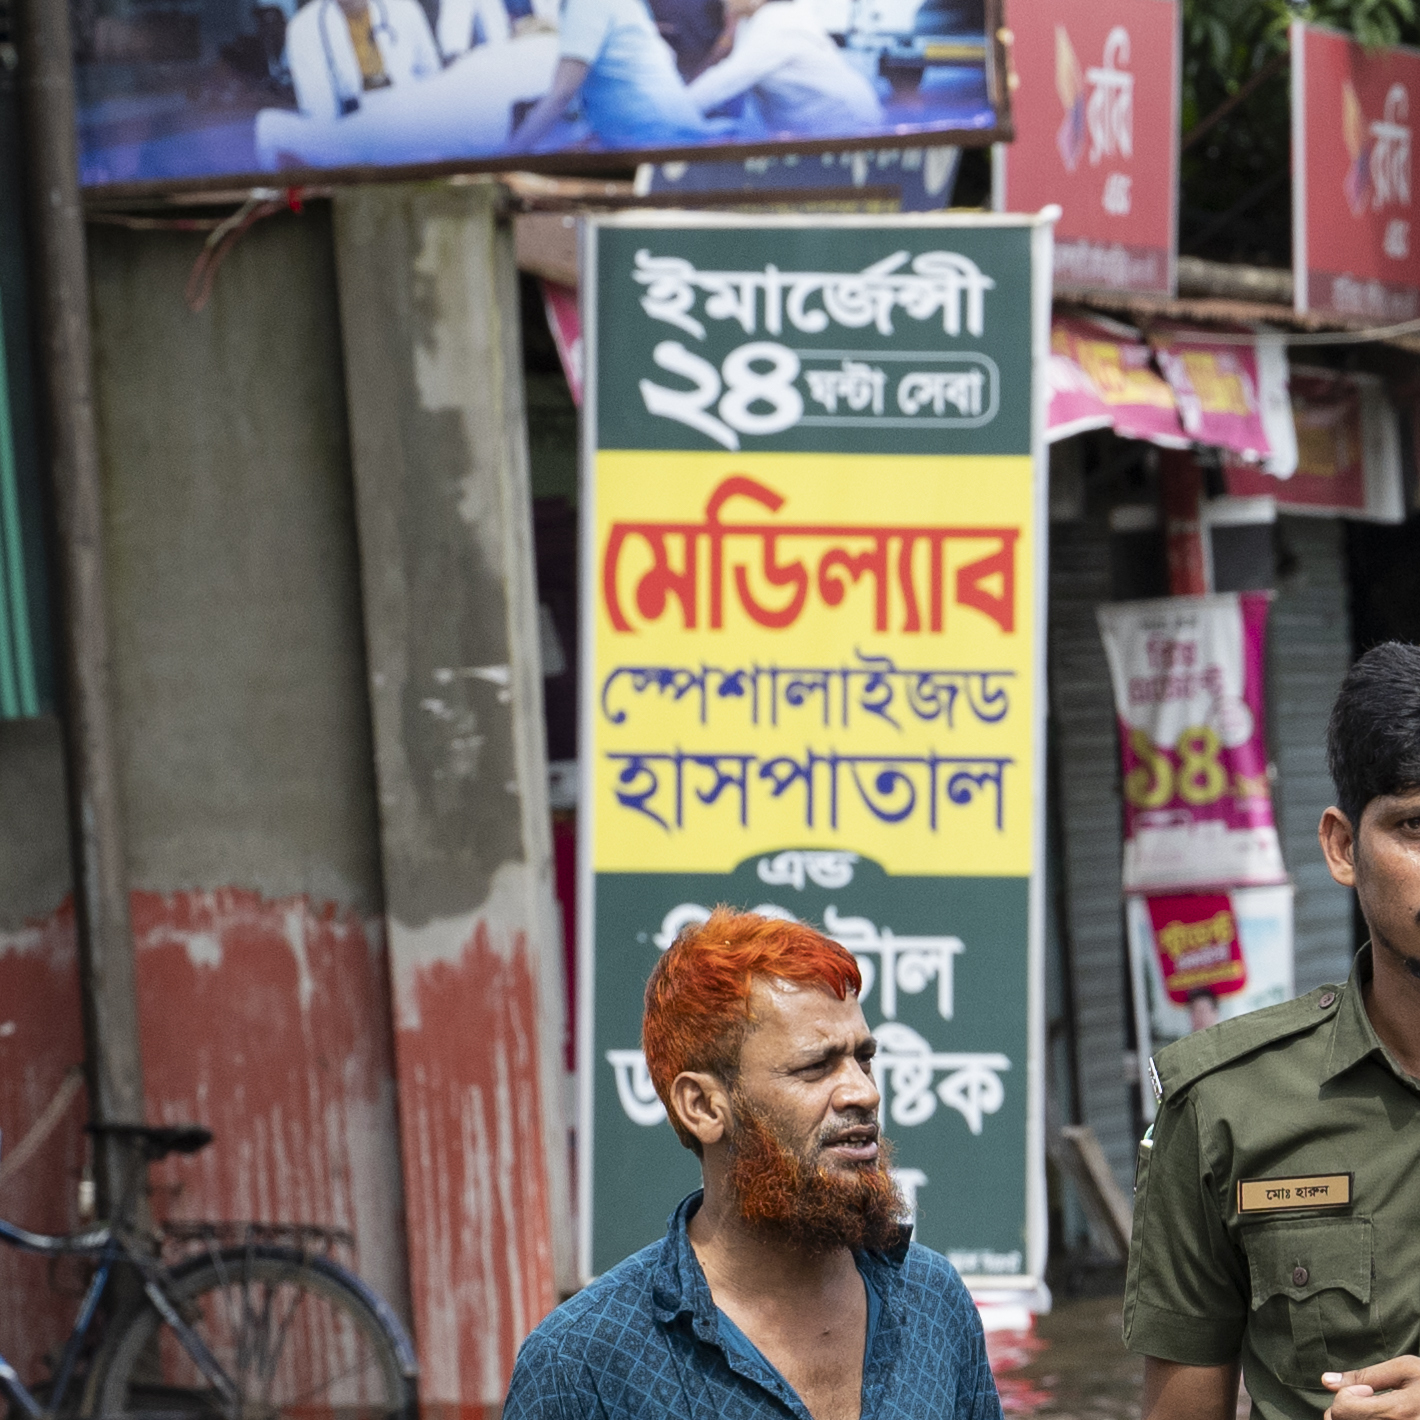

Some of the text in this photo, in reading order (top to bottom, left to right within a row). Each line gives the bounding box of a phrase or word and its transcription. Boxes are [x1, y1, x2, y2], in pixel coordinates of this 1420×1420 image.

[639, 340, 805, 453] ২৪
[897, 367, 986, 416] সেবা
[602, 474, 1021, 635] মেডিল্যাব
[600, 647, 1018, 732] স্পেশালাইজড
[605, 745, 1018, 834] হাসপাতাল
[1265, 1185, 1330, 1201] মোঃ হারুন
